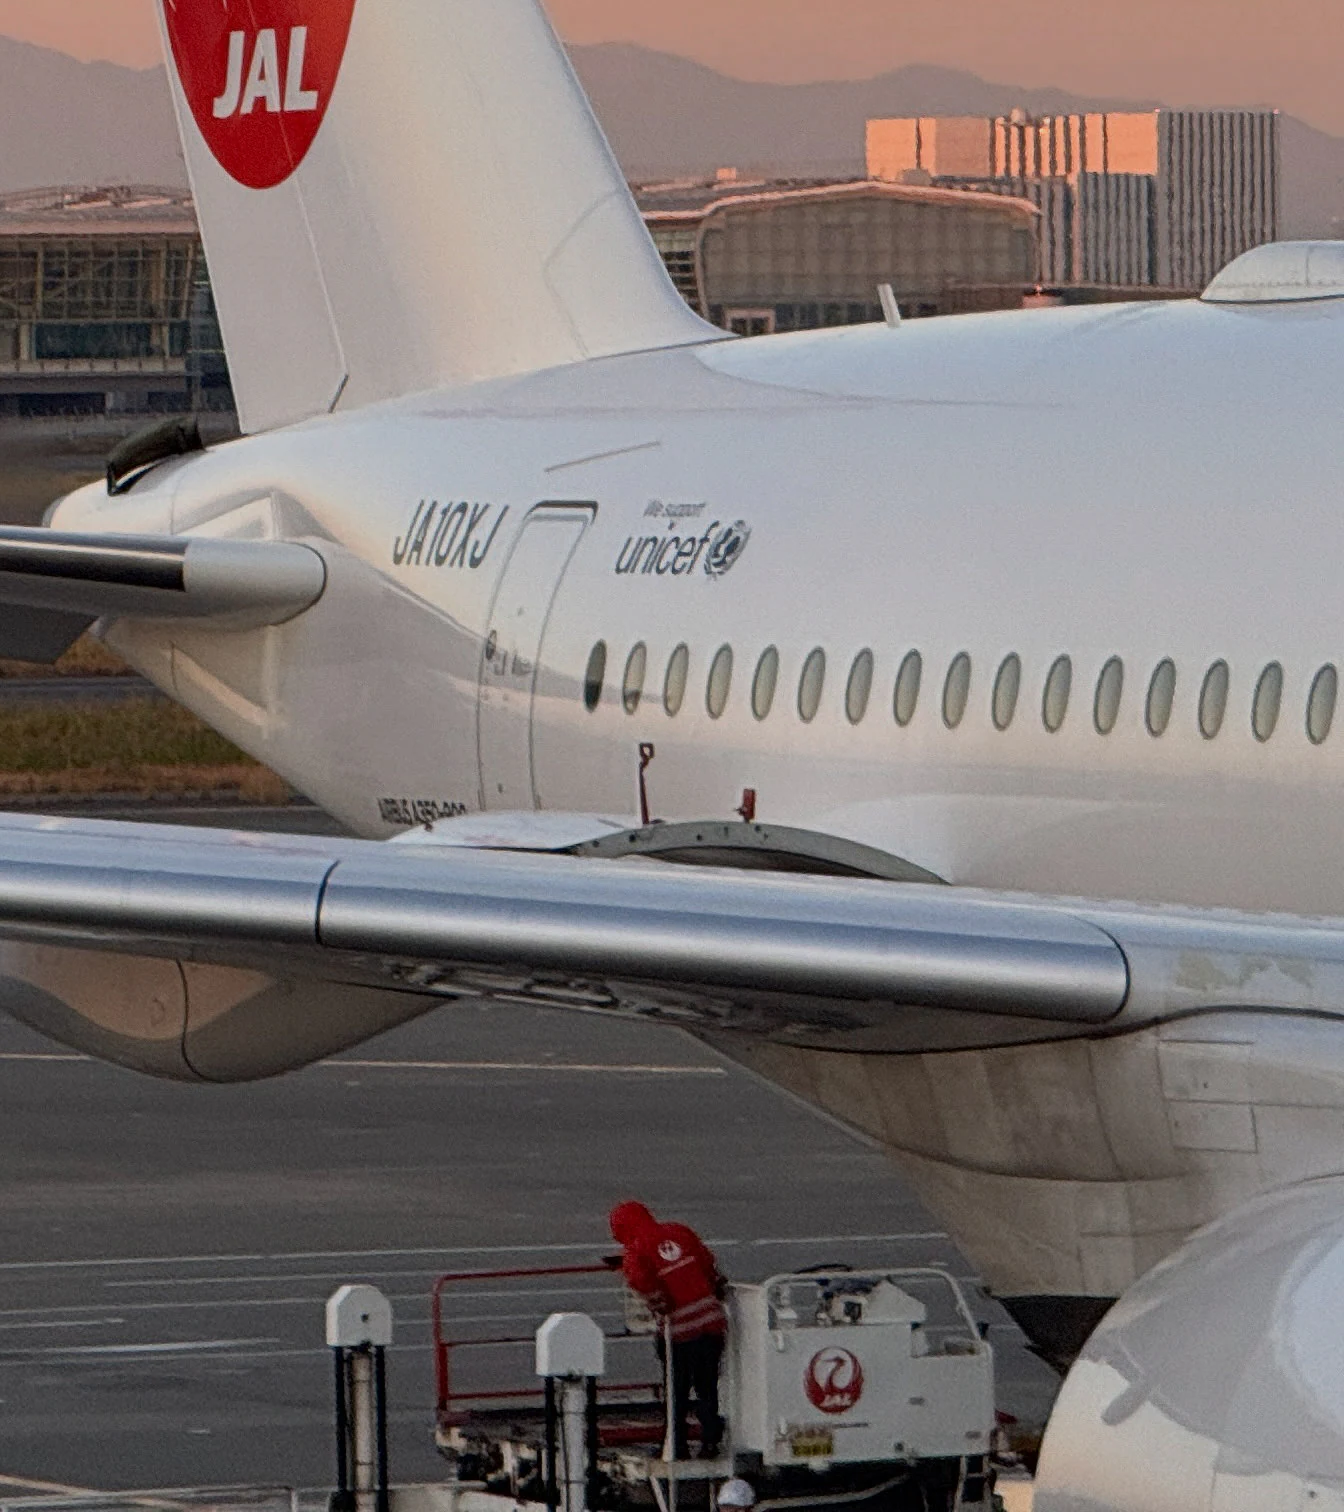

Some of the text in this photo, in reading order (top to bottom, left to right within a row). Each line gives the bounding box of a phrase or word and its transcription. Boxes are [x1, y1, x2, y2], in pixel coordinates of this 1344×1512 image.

[212, 26, 318, 119] JAL
[393, 499, 510, 569] JA10XJ
[615, 520, 720, 575] unicef
